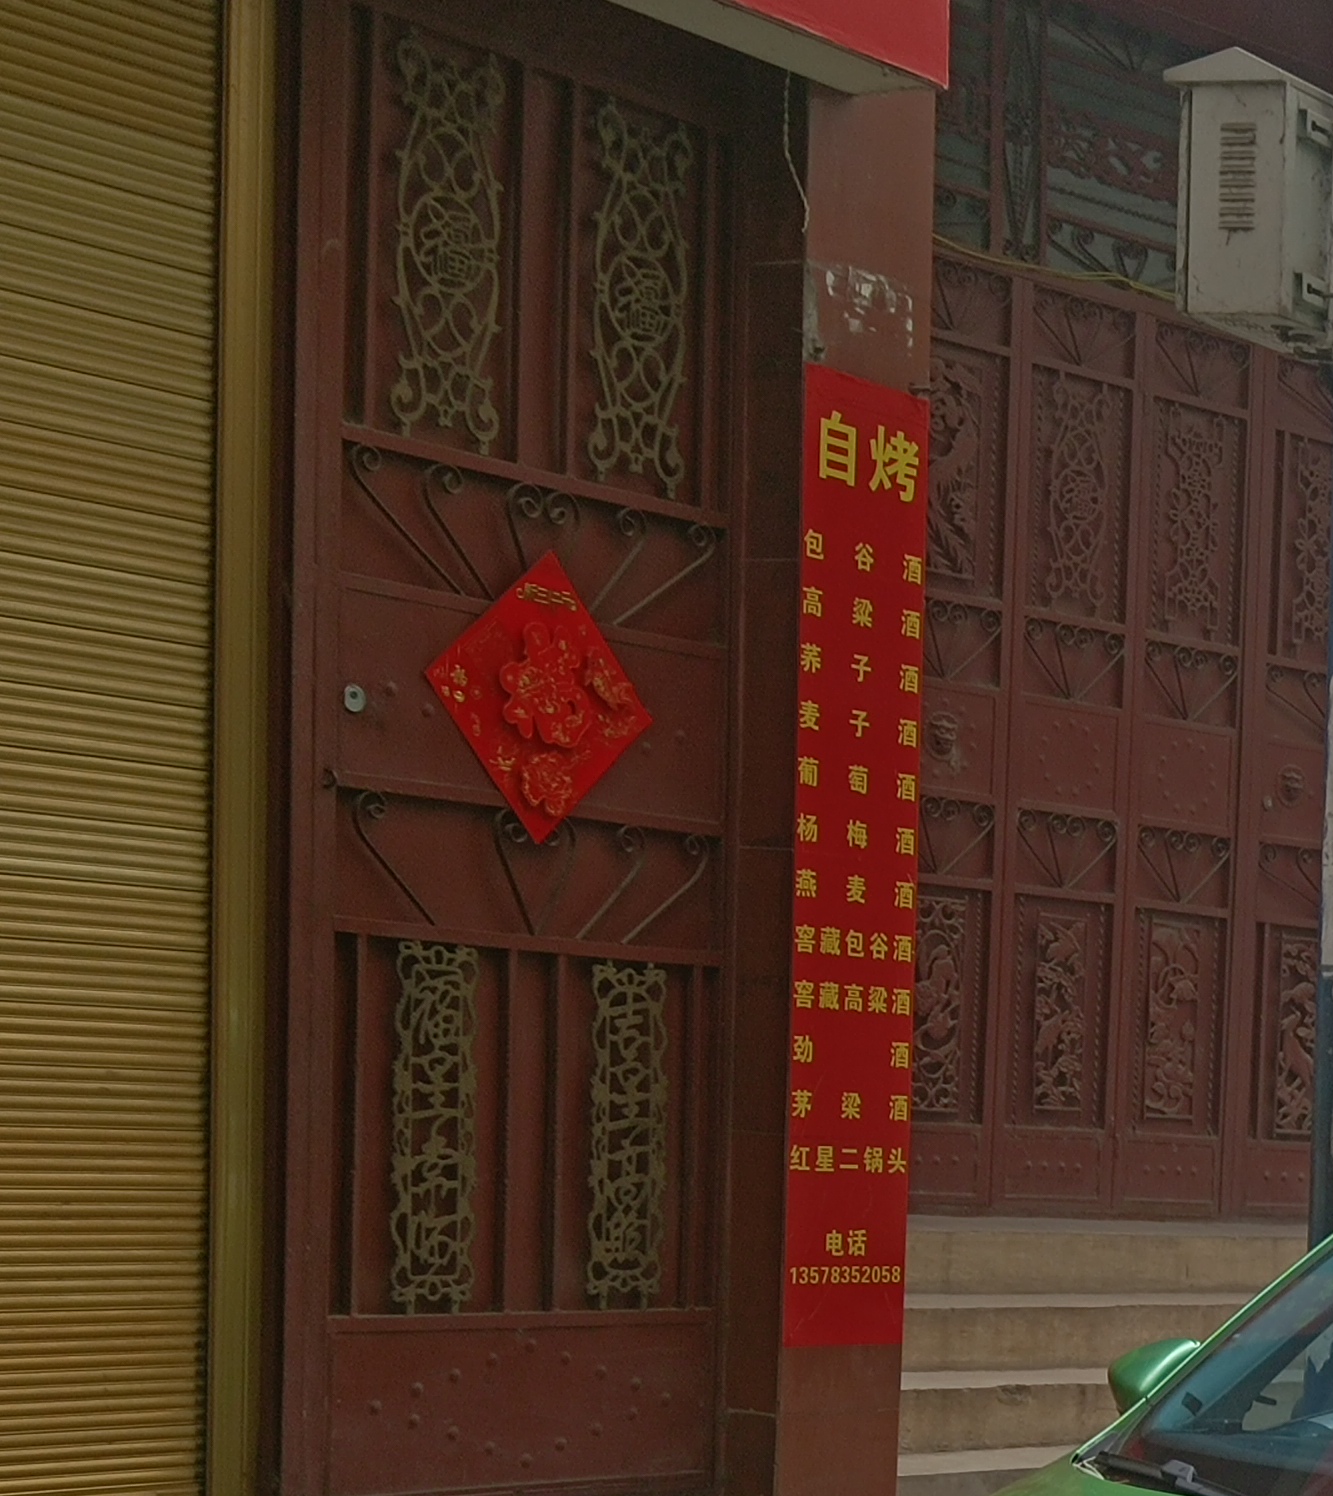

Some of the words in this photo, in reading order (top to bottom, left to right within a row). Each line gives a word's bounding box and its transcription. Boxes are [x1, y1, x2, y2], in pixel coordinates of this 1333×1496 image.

[818, 410, 920, 503] 自烤
[803, 529, 922, 585] 包谷酒
[798, 700, 918, 749] 麦子酒
[797, 756, 916, 802] 葡萄酒
[796, 812, 916, 856] 杨梅酒
[795, 869, 914, 909] 燕麦酒
[794, 924, 912, 963] 窖藏包谷酒
[794, 1034, 910, 1069] 劲酒
[789, 1145, 907, 1174] 红星二锅头
[825, 1230, 867, 1258] 电话
[790, 1265, 901, 1285] 13578352058
